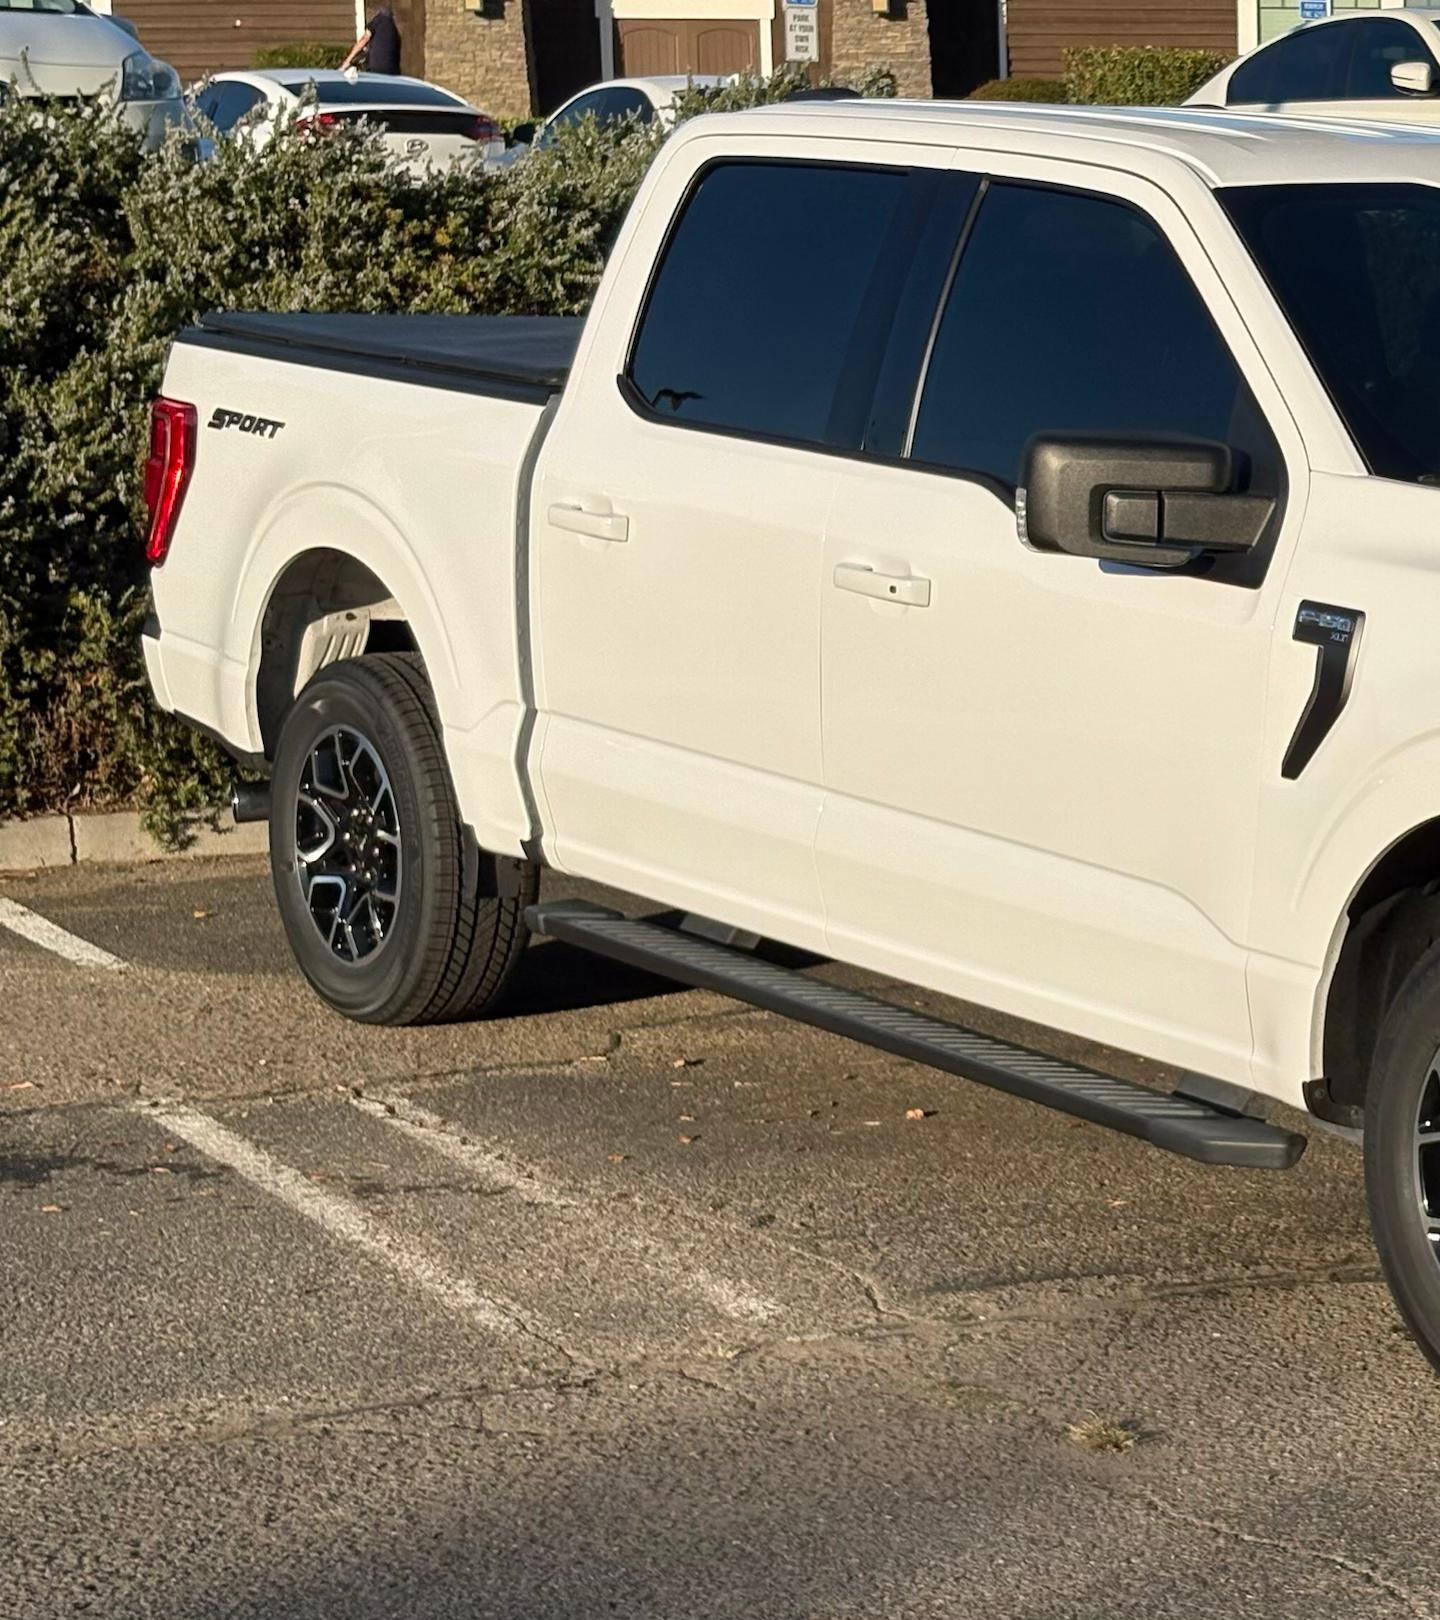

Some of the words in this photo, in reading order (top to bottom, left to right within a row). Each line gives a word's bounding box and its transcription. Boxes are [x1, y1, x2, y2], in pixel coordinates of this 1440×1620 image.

[207, 408, 285, 439] SPORT
[1299, 609, 1351, 632] F-150
[1330, 631, 1348, 642] XLT
